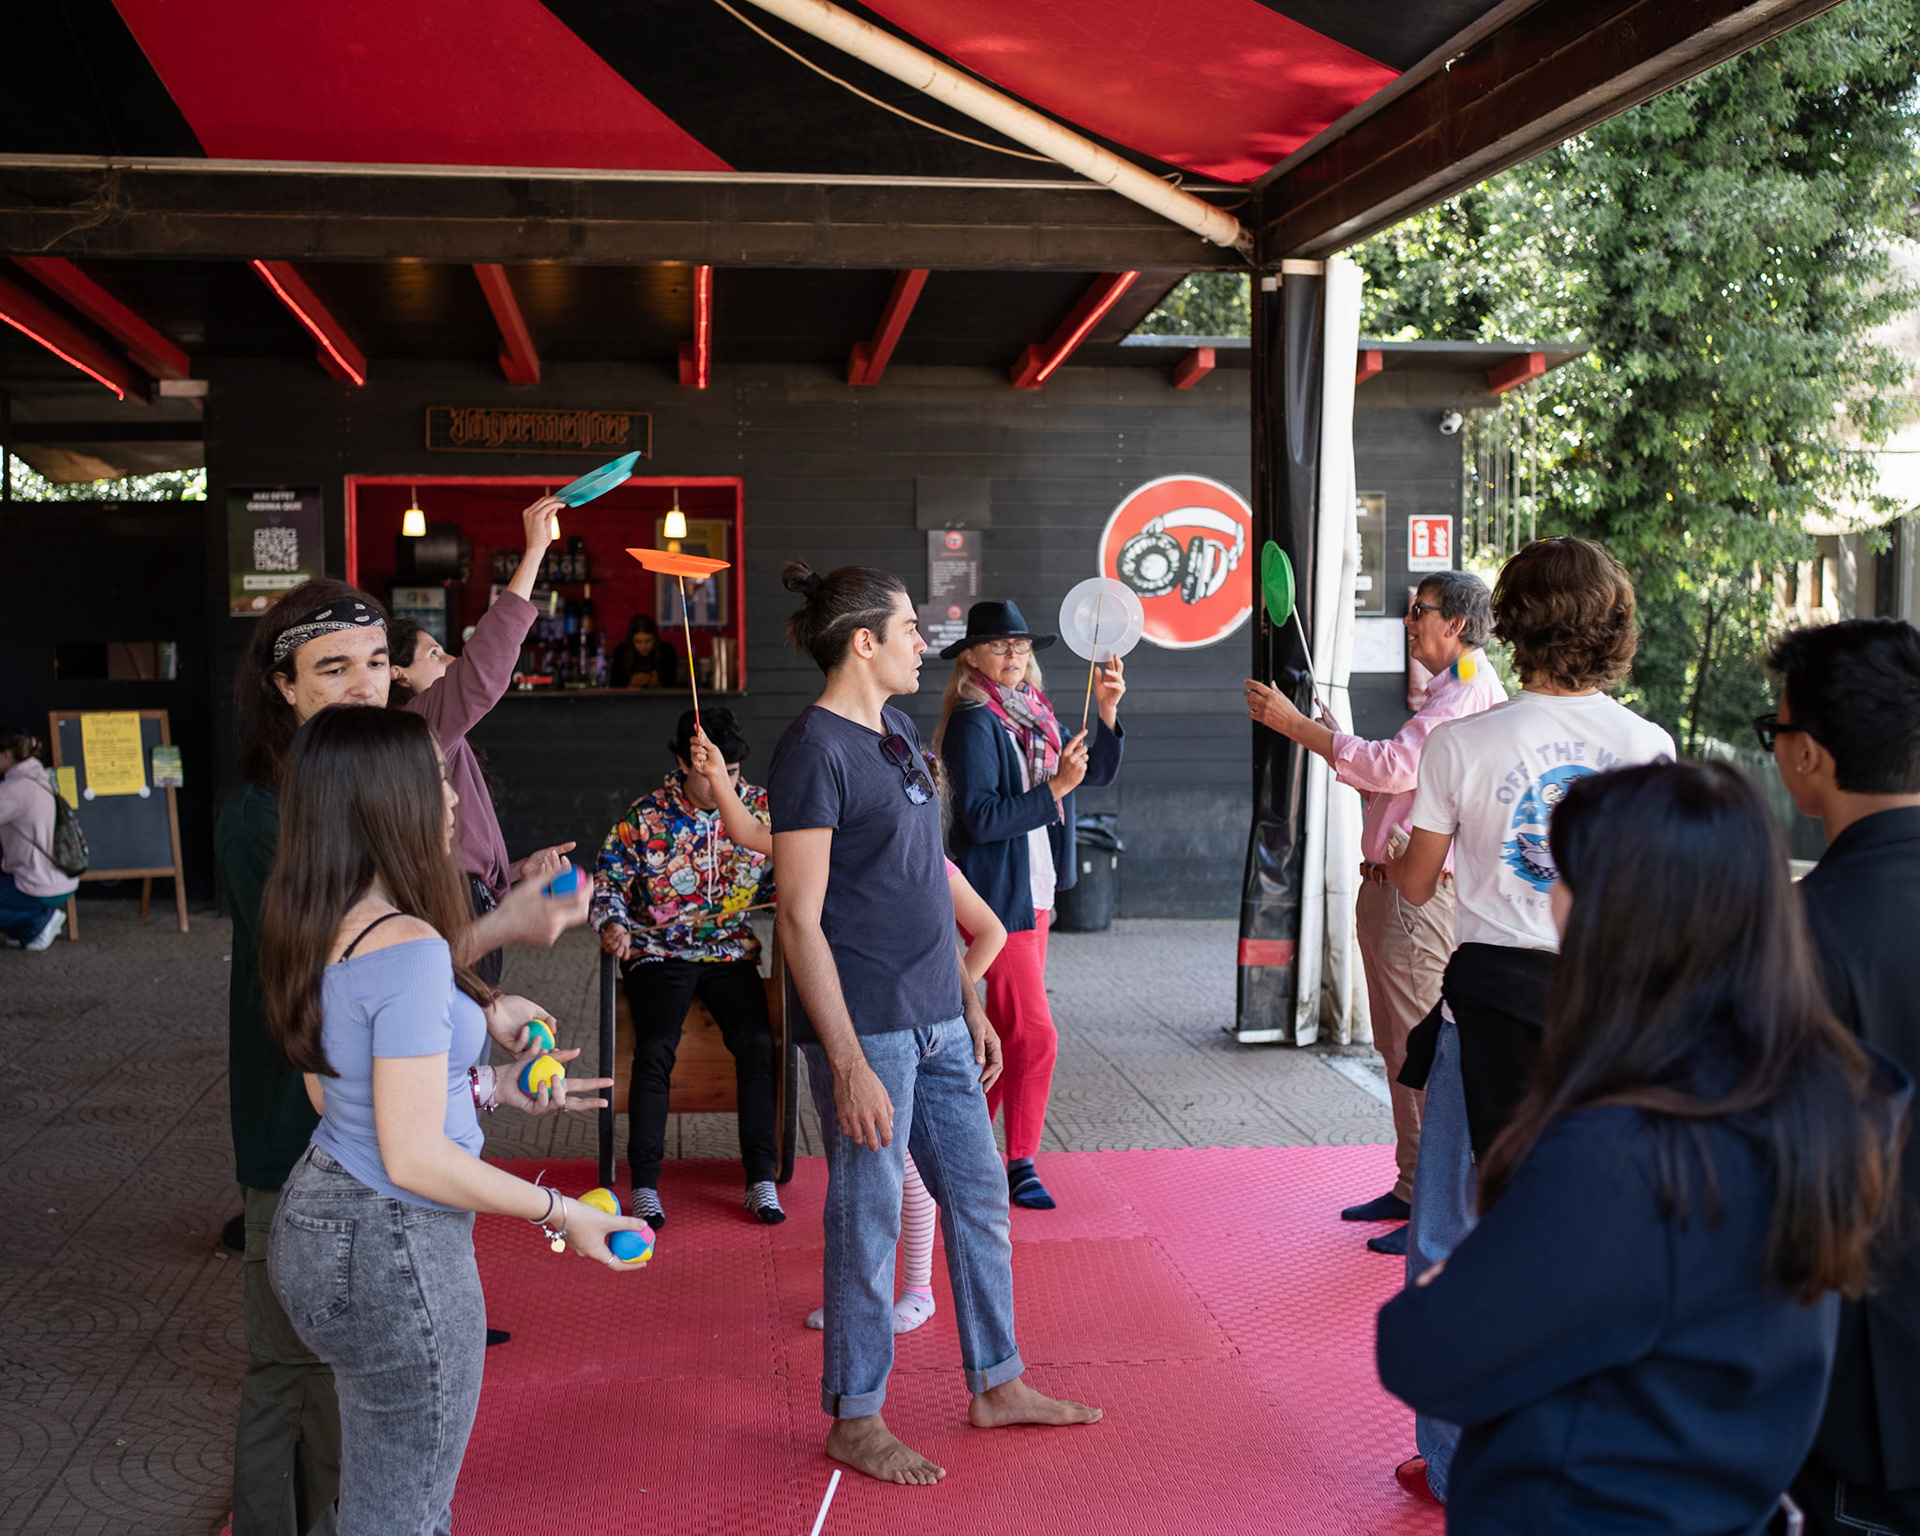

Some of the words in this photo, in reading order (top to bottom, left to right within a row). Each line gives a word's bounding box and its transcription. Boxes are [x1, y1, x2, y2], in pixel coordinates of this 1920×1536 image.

[1495, 760, 1531, 805] OFF
[1535, 741, 1586, 766] THE
[1595, 746, 1623, 769] W
[1504, 893, 1548, 908] SINC
